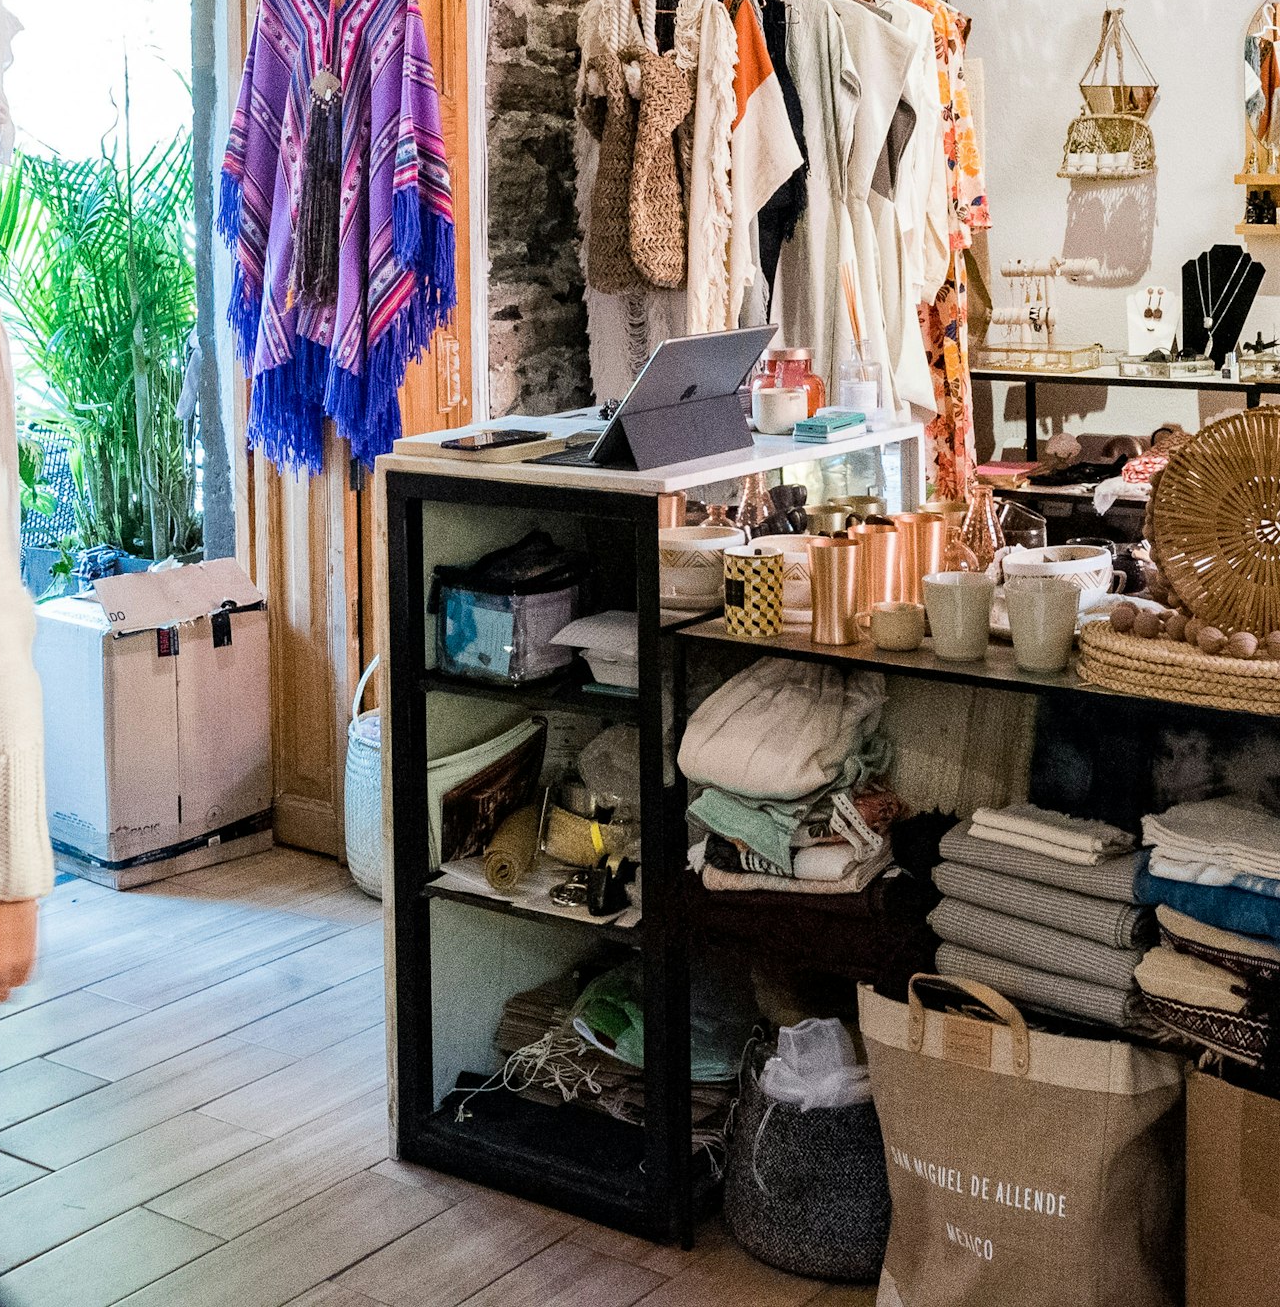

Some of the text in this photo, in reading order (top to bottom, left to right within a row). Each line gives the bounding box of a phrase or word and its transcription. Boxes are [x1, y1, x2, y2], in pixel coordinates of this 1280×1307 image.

[890, 1145, 1067, 1219] SAN MIGUEL DE ALLENDE
